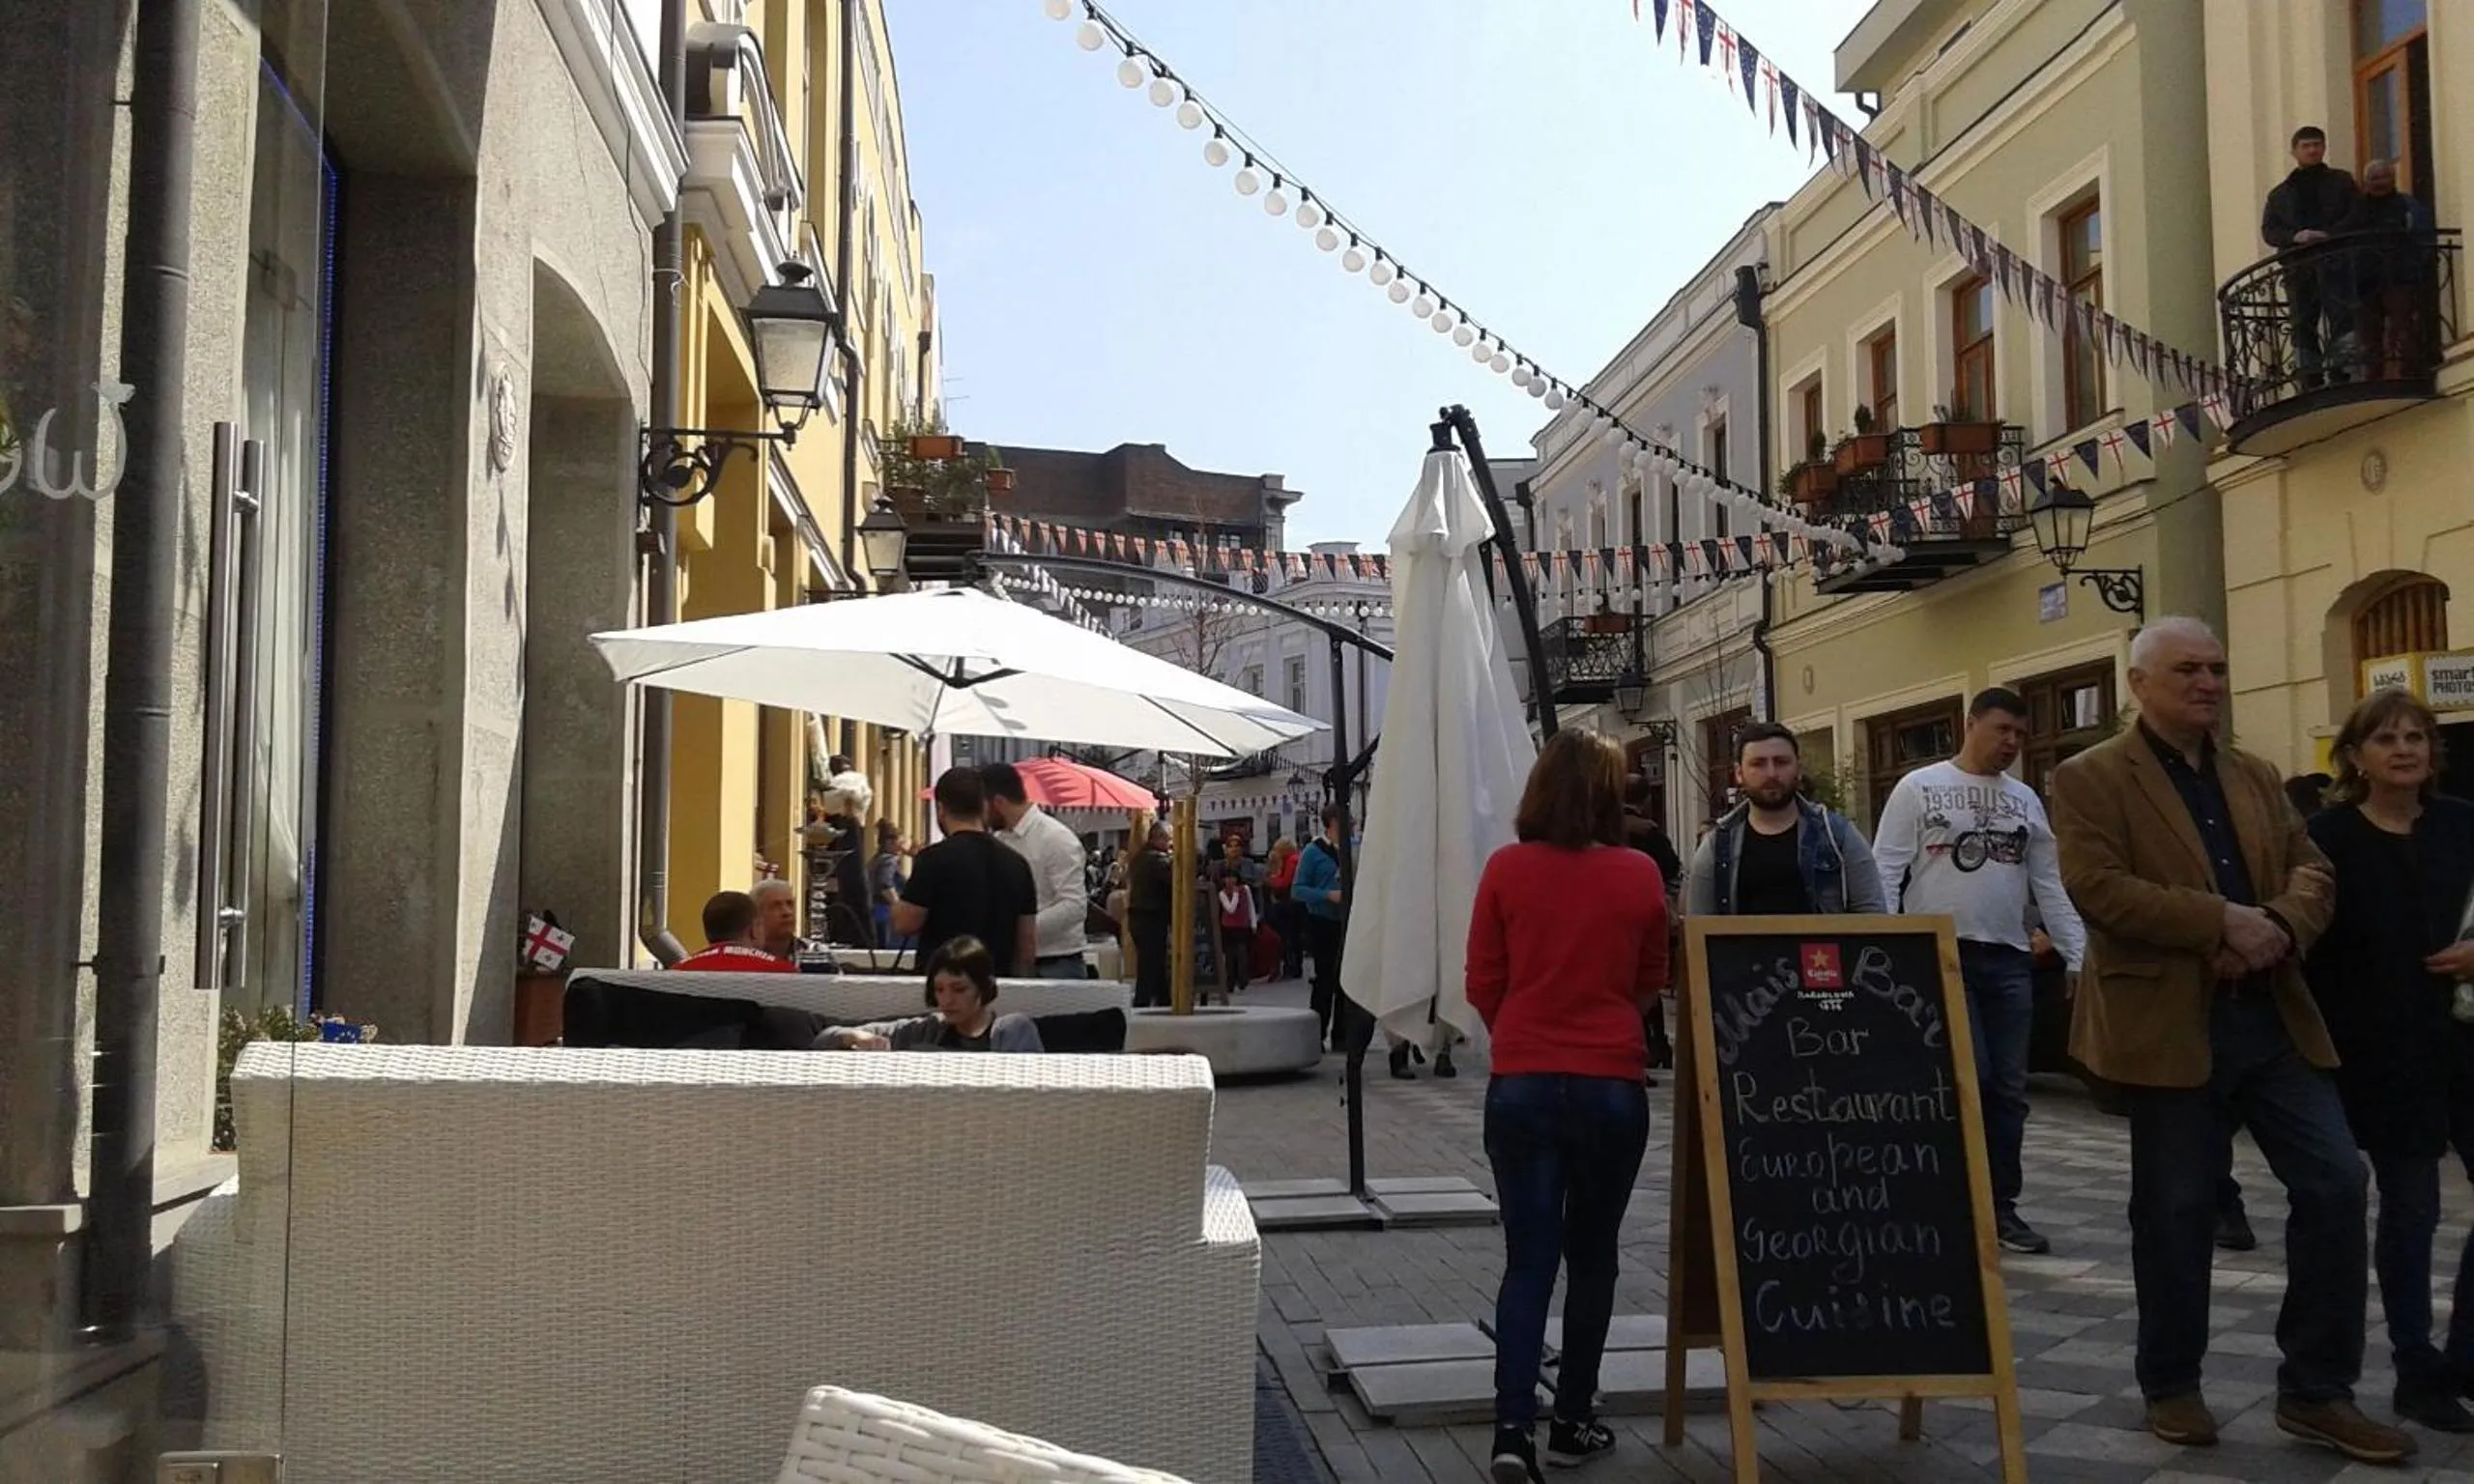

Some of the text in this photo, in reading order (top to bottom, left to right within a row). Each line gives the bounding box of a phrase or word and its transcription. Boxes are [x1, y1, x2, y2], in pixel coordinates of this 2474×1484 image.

[1923, 793, 1966, 813] 1930
[1788, 1016, 1870, 1056] Bar
[1733, 1068, 1956, 1125] Restaurant
[1739, 1132, 1940, 1188] European
[1812, 1177, 1890, 1213] and
[1755, 1280, 1956, 1332] Cuisine
